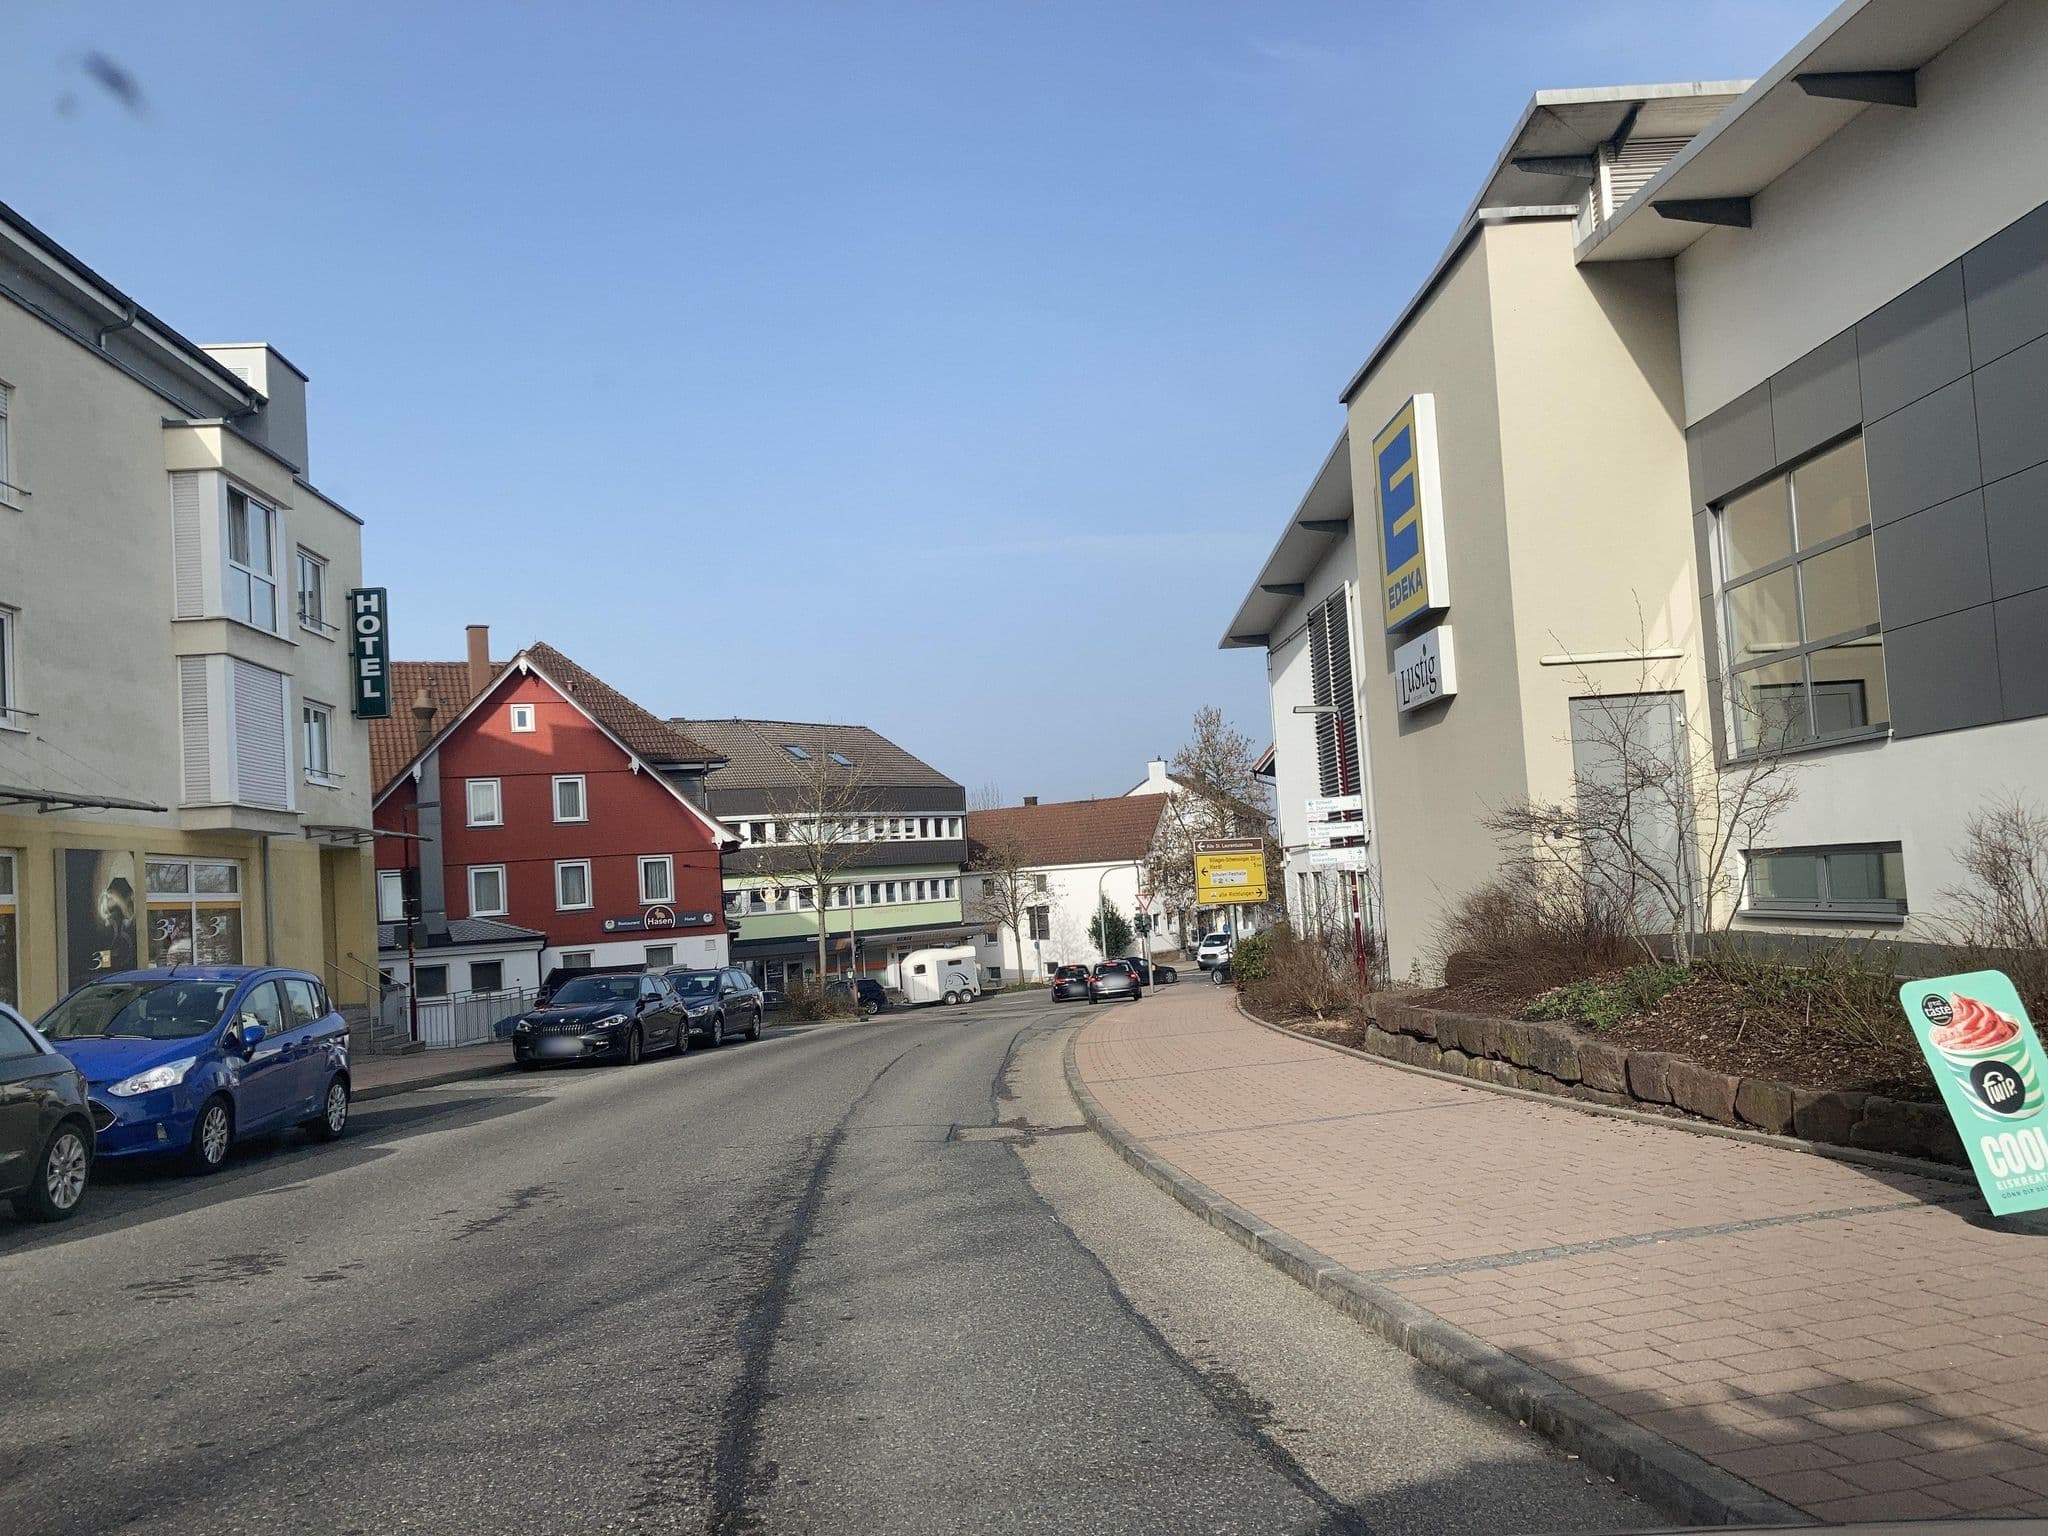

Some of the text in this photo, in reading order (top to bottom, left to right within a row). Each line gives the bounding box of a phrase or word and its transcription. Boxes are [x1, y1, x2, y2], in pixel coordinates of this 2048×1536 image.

[1389, 568, 1423, 610] EDEKA
[356, 594, 381, 698] HOTEL
[1401, 643, 1437, 705] Lustig
[647, 917, 673, 926] Hasen
[1925, 1006, 1952, 1017] taste
